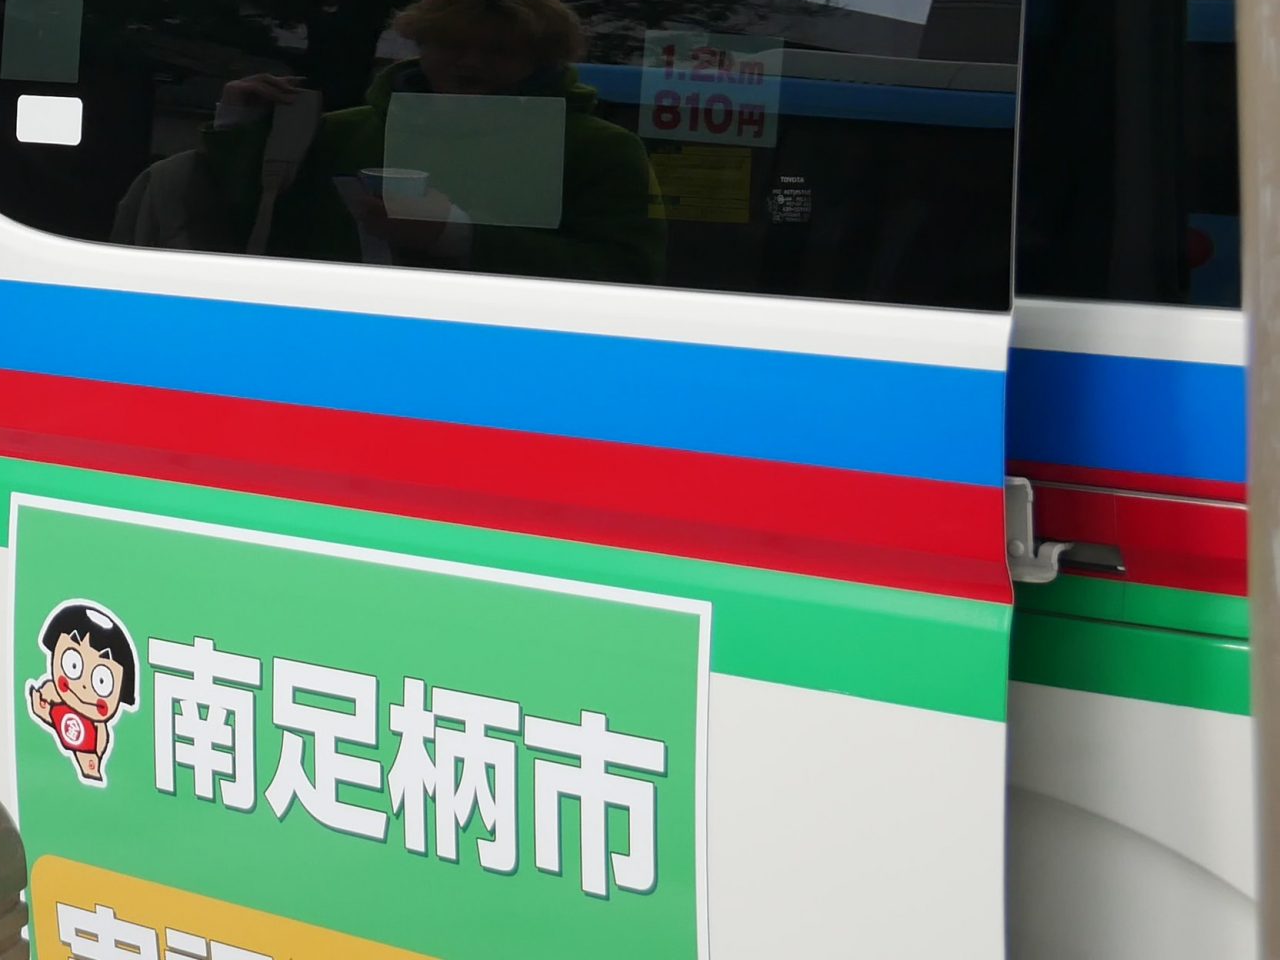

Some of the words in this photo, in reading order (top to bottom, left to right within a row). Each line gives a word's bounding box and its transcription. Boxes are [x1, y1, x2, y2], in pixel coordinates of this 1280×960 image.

[652, 89, 766, 139] 810円
[147, 636, 667, 900] 南足柄市
